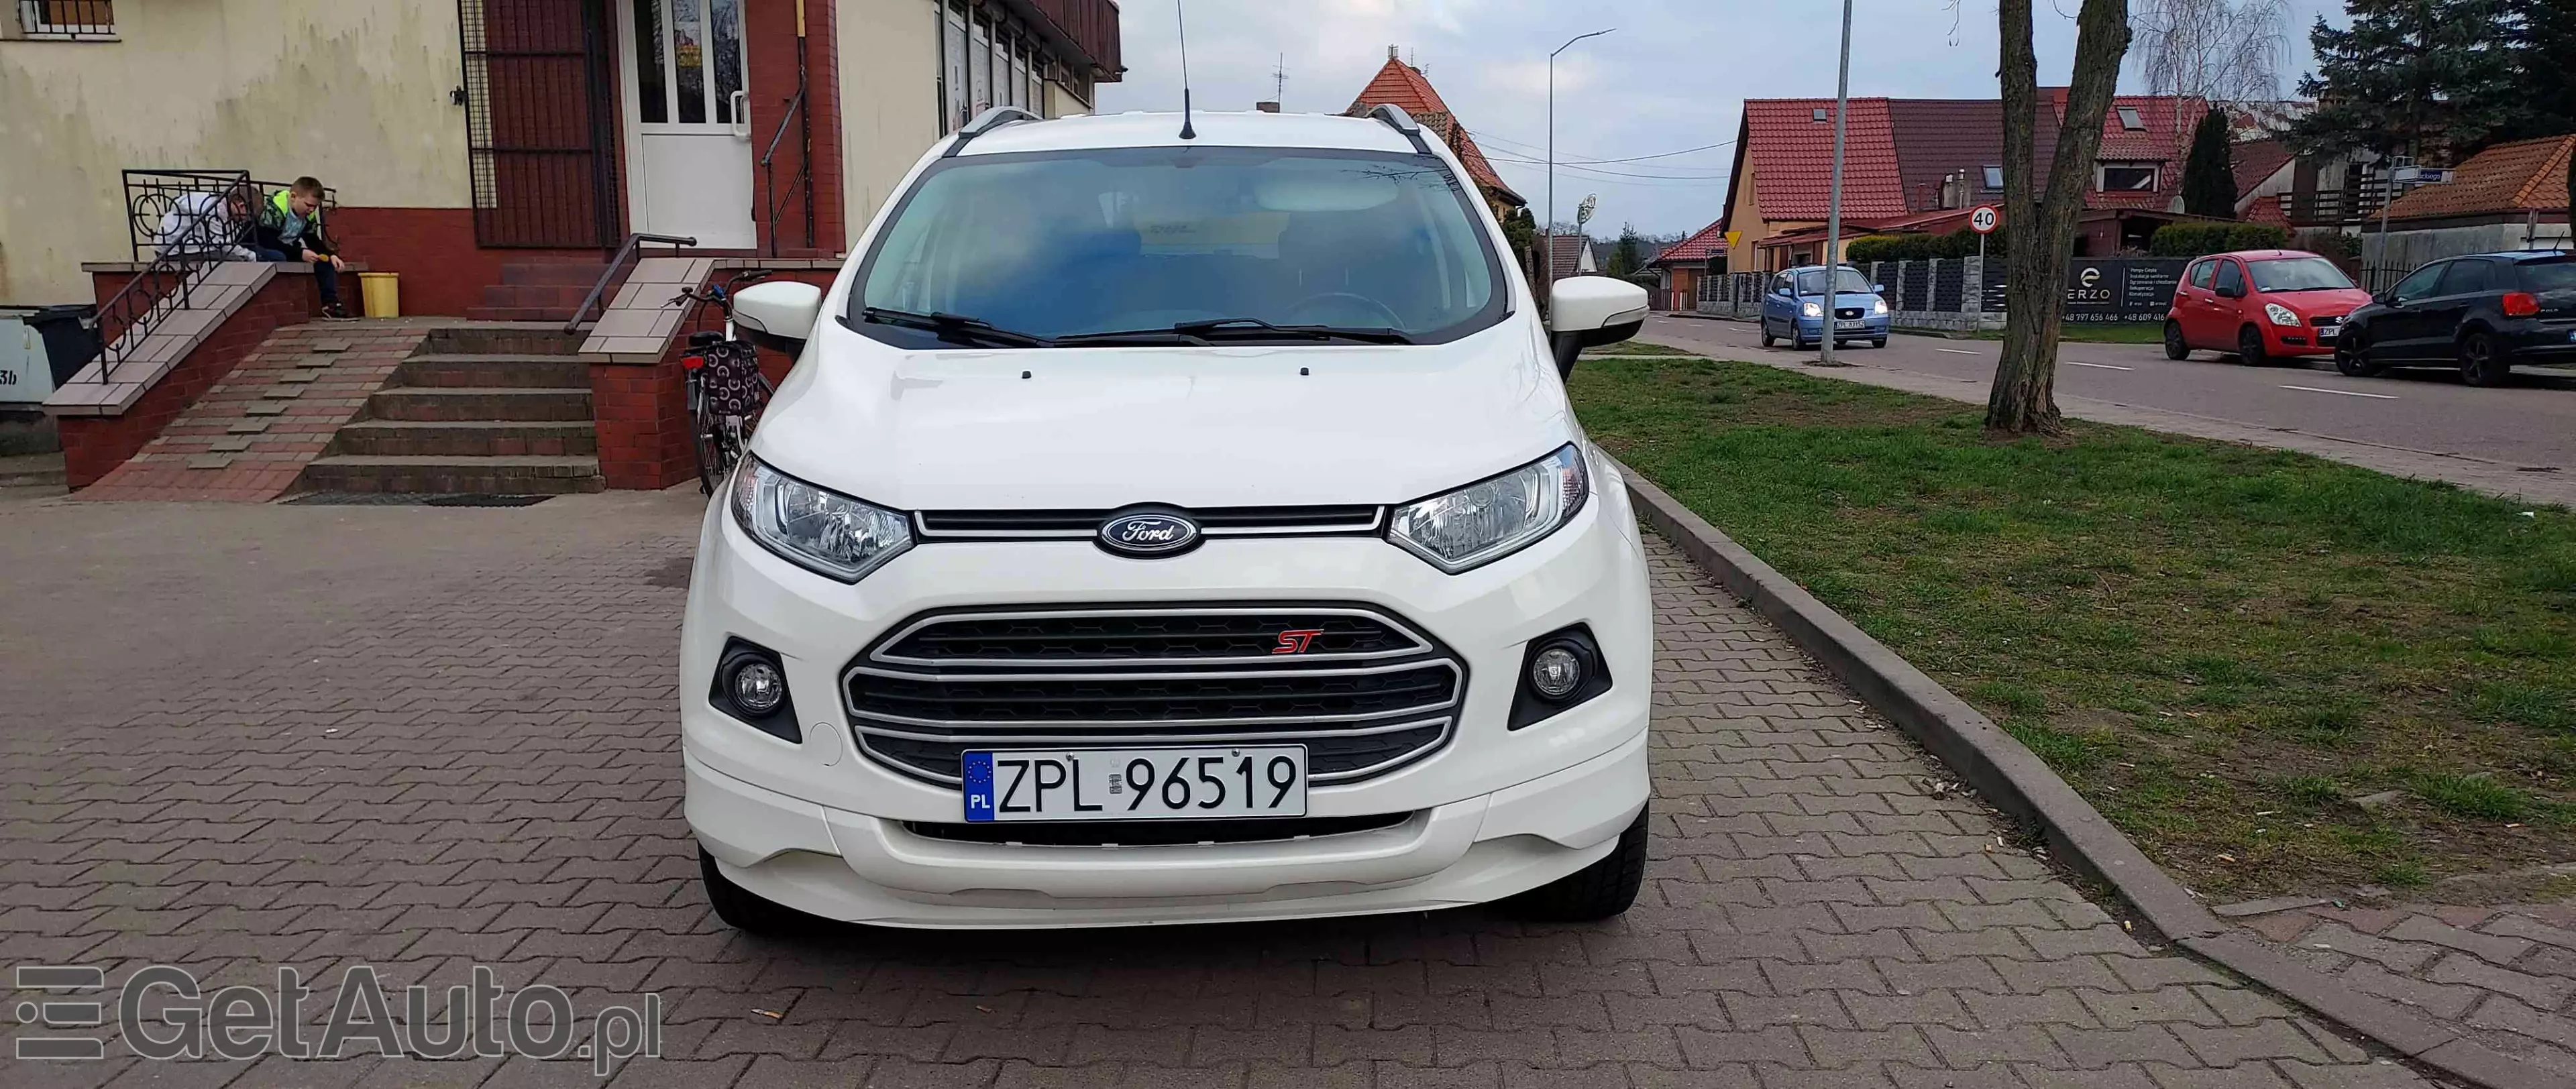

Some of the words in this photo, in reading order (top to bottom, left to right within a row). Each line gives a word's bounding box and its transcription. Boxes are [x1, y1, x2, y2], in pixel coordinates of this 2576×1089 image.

[1974, 213, 1994, 226] 40
[2068, 289, 2110, 299] ERZO
[2061, 313, 2074, 321] +48
[2076, 313, 2089, 321] 797
[2090, 313, 2103, 321] 656
[2105, 313, 2118, 321] 466
[2125, 313, 2137, 321] +48
[2139, 313, 2151, 321] 609
[2153, 313, 2165, 321] 416
[1122, 520, 1175, 541] Ford
[1272, 629, 1324, 654] ST
[997, 758, 1103, 813] ZPL
[1125, 755, 1297, 811] 96519
[970, 795, 991, 809] PL
